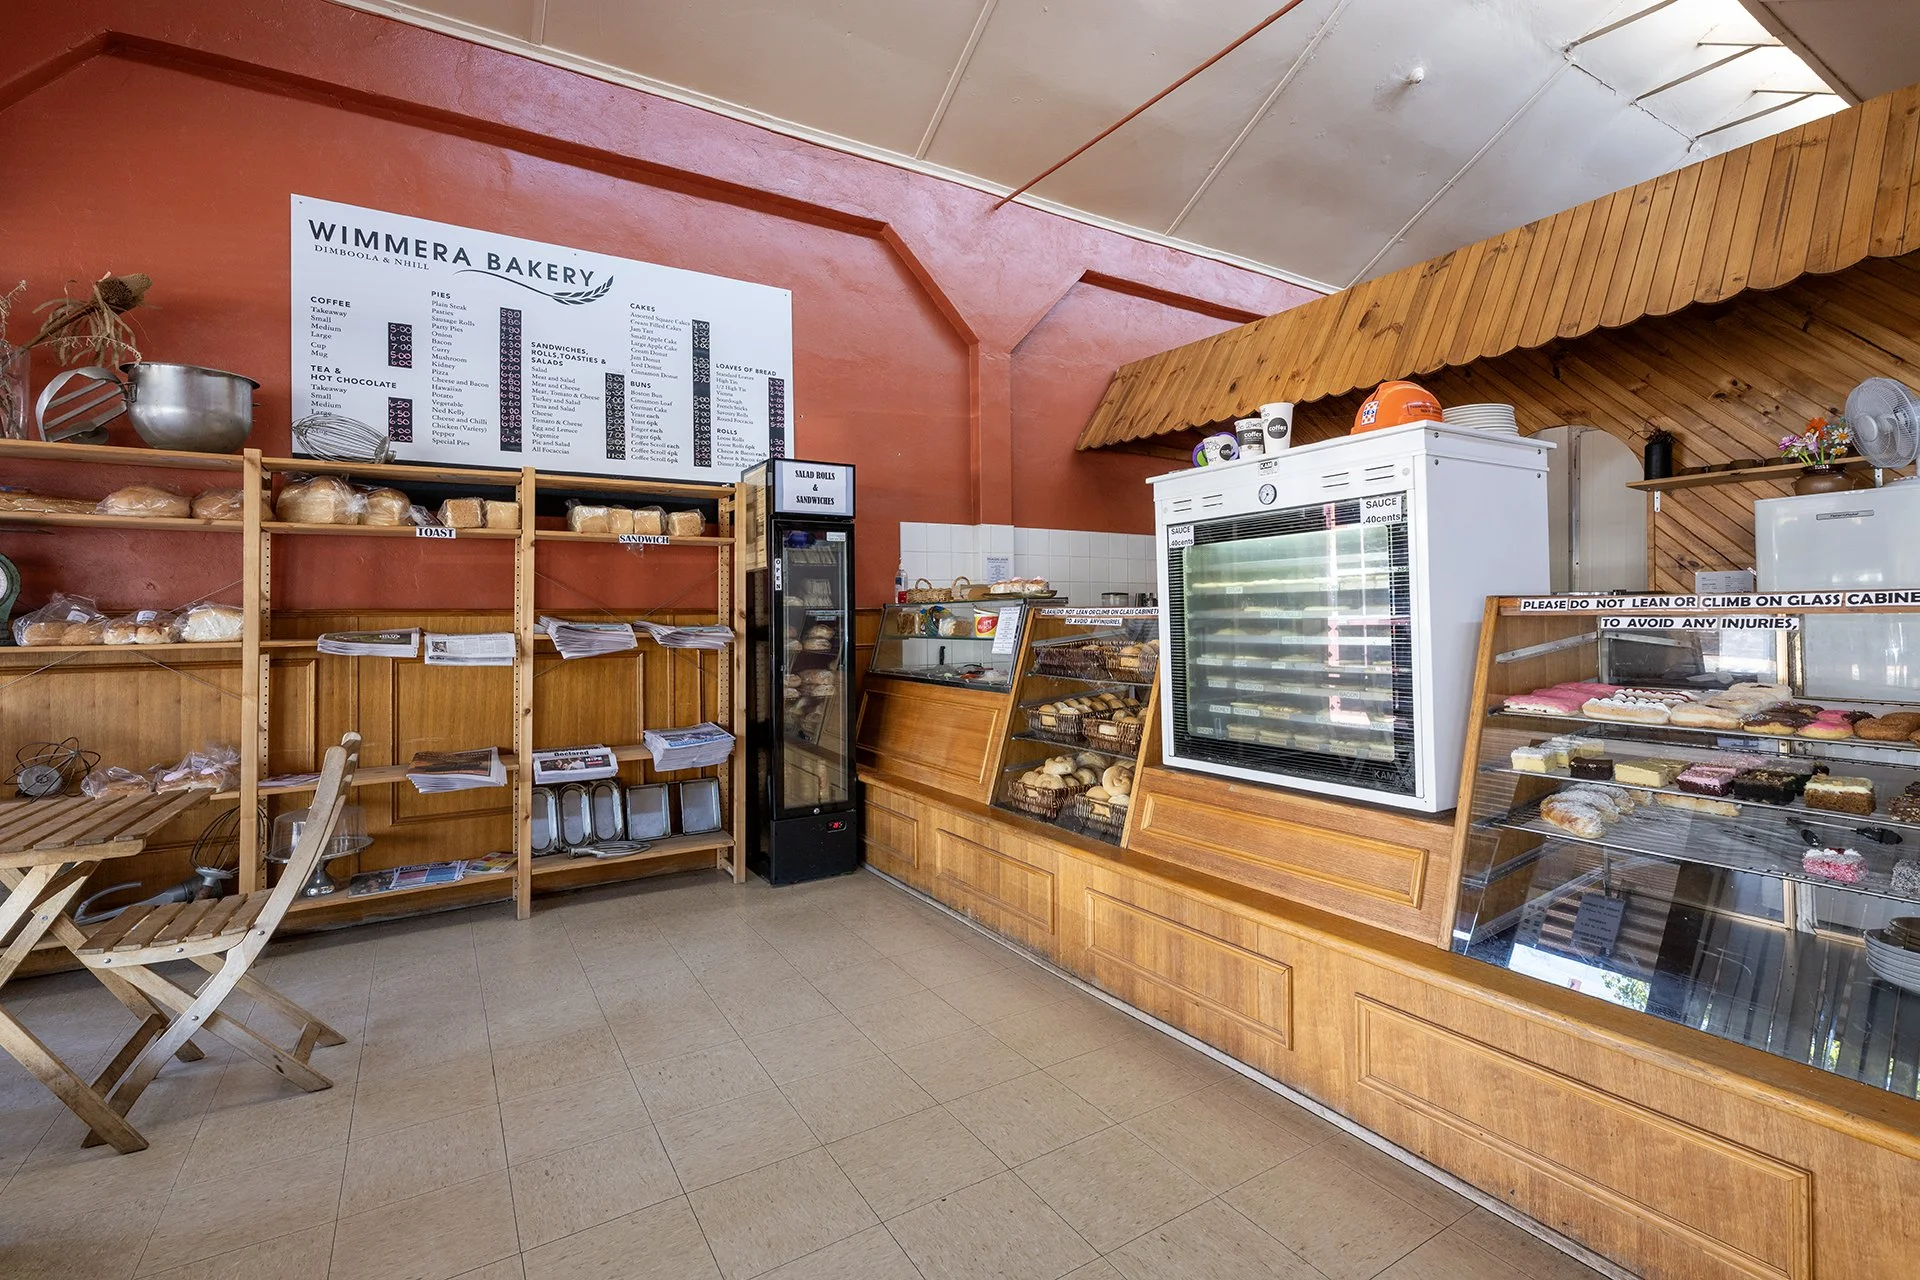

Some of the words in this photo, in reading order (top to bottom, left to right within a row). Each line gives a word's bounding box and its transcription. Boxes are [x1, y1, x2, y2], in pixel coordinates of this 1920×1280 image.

[308, 219, 472, 267] WIMMERA
[488, 252, 594, 287] BAKERY
[315, 245, 379, 262] DIMBOOLA
[382, 256, 390, 264] &
[394, 258, 430, 270] NHILL
[431, 291, 451, 299] PIES
[311, 296, 351, 308] COFFEE
[432, 300, 448, 308] Plain
[311, 306, 347, 318] Takeaway
[432, 308, 454, 316] Pasties
[630, 303, 655, 312] CAKES
[311, 315, 332, 323] Small
[432, 316, 457, 324] Sausage
[311, 323, 341, 332] Medium
[432, 323, 448, 331] Party
[311, 331, 332, 340] Large
[311, 342, 326, 350] Cup
[432, 338, 452, 346] Bacon
[432, 346, 450, 354] Curry
[531, 342, 589, 355] SANDWICHES,
[311, 350, 328, 358] Mug
[432, 354, 467, 363] Mushroom
[432, 361, 456, 370] Kidney
[531, 357, 563, 366] SALADS
[311, 365, 330, 373] TEA
[716, 363, 742, 372] LOAVES
[337, 377, 397, 389] CHOCOLATE
[432, 377, 455, 385] Cheese
[311, 384, 347, 394] Takeaway
[432, 384, 462, 392] Hawaiian
[311, 392, 331, 400] Small
[551, 390, 572, 398] Tomato
[311, 401, 342, 409] Medium
[432, 399, 463, 408] Vegetable
[448, 408, 465, 416] Kelly
[532, 417, 555, 425] Tomato
[432, 422, 458, 430] Chicken
[795, 470, 815, 479] SALAD
[816, 471, 835, 480] ROLLS
[813, 484, 819, 492] &
[796, 495, 835, 506] SANDWICHES
[1366, 498, 1397, 509] SAUCE
[1363, 514, 1400, 524] .40cents
[419, 528, 454, 538] TOAST
[1171, 526, 1191, 535] SAUCE
[619, 535, 669, 544] SANDWICH
[1523, 599, 1567, 610] PLEASE
[1570, 600, 1589, 609] DO
[1596, 599, 1625, 608] NOT
[1632, 598, 1670, 608] LEAN
[1674, 597, 1696, 607] OR
[1702, 596, 1751, 607] CLIMB
[1756, 595, 1782, 606] ON
[1788, 593, 1841, 606] GLASS
[1602, 618, 1620, 628] TO
[1627, 618, 1674, 628] AVOID
[1682, 618, 1717, 628] ANY
[1722, 618, 1799, 630] INJURIES,
[1374, 770, 1394, 780] KAM
